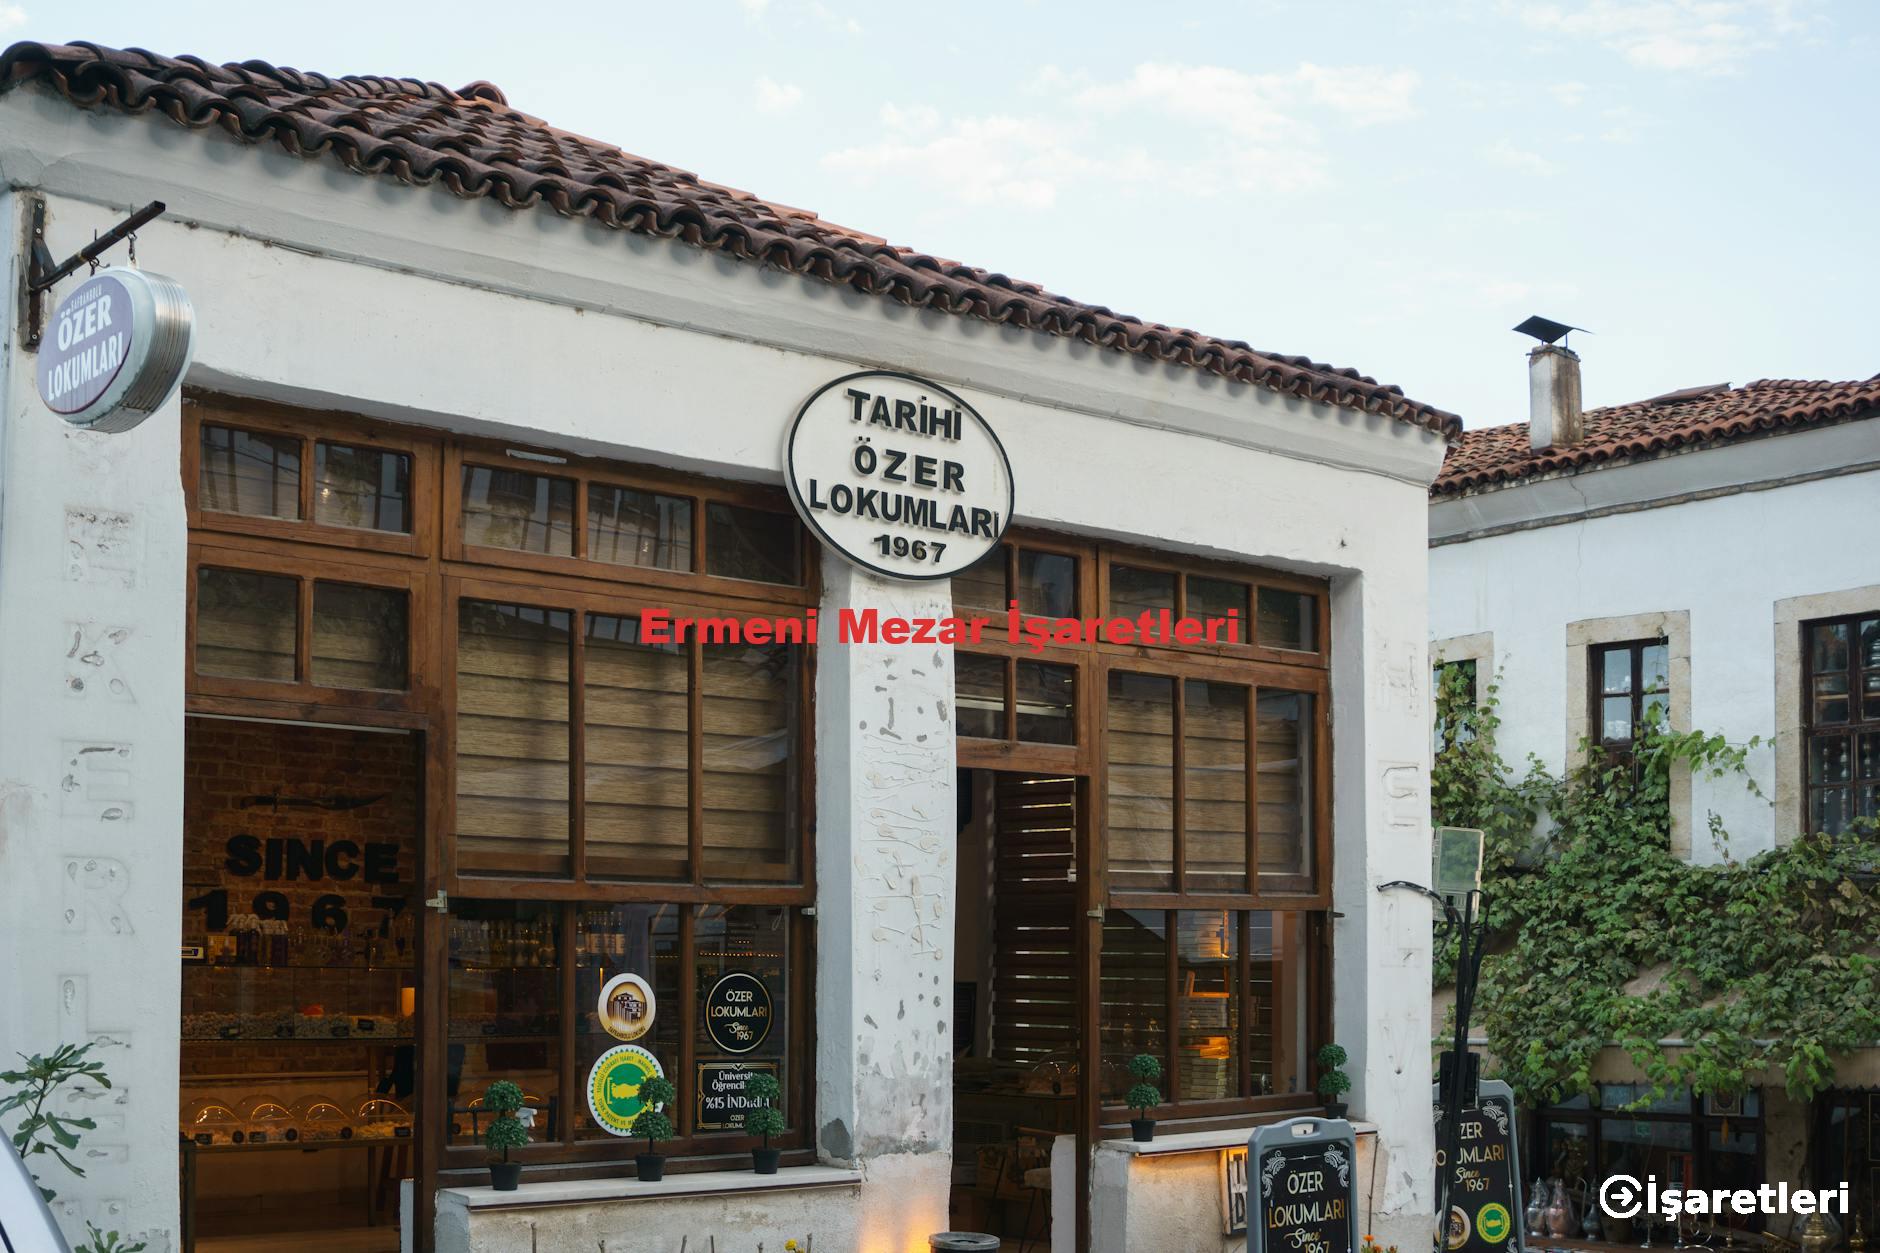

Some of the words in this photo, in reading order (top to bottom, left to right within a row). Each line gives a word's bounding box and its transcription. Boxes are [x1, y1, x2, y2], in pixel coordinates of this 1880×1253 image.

[57, 295, 112, 352] ÖZER
[48, 332, 123, 401] LOKUMLARI
[847, 388, 962, 440] TARİHİ
[854, 436, 965, 492] ÖZER
[873, 534, 947, 563] 1967
[225, 834, 400, 883] SINCE
[725, 988, 753, 1002] ÖZER
[711, 1006, 768, 1017] LOKUMLARI
[736, 1031, 753, 1040] 1967
[706, 1097, 725, 1109] %15
[1461, 1121, 1483, 1139] ZER
[1287, 1170, 1324, 1194] ÖZER
[1455, 1167, 1479, 1183] Since
[1466, 1178, 1489, 1192] 1967
[1269, 1199, 1345, 1229] LOKUMLARI
[1284, 1228, 1321, 1248] Since
